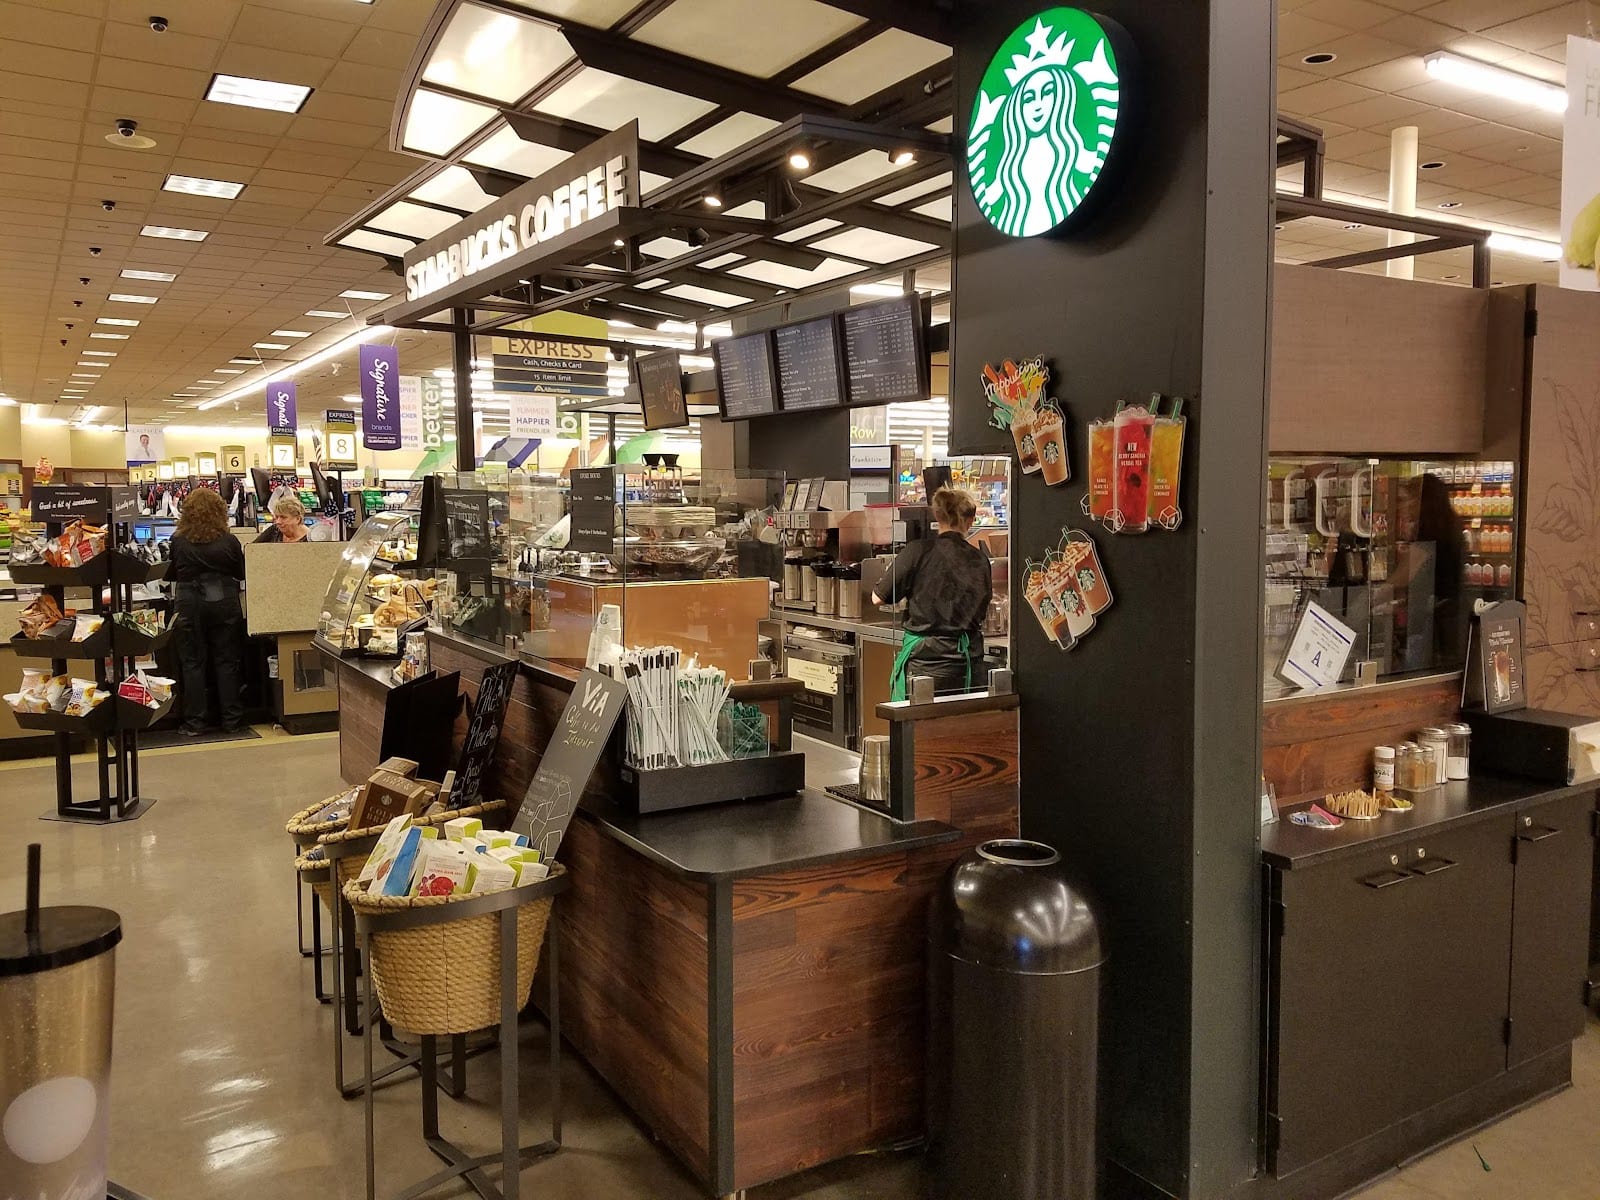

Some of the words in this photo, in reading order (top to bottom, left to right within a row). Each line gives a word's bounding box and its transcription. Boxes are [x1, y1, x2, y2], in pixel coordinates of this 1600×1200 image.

[406, 214, 518, 301] STARBUCKS
[519, 155, 627, 249] COFFEE
[508, 338, 593, 359] EXPRESS
[523, 358, 540, 367] Cash,
[540, 359, 562, 368] Checks
[562, 360, 567, 368] &
[568, 361, 582, 369] Card
[368, 358, 390, 422] Signature
[273, 391, 290, 427] Signatu
[422, 380, 441, 448] better
[371, 423, 392, 431] brands
[516, 416, 550, 425] HAPPIER
[850, 425, 876, 440] Row
[336, 438, 347, 455] 8
[1127, 442, 1138, 452] NEW
[230, 456, 240, 468] 6
[279, 449, 288, 461] 7
[148, 470, 154, 478] 2
[65, 499, 72, 510] of
[1310, 650, 1322, 668] A
[467, 715, 498, 754] Place
